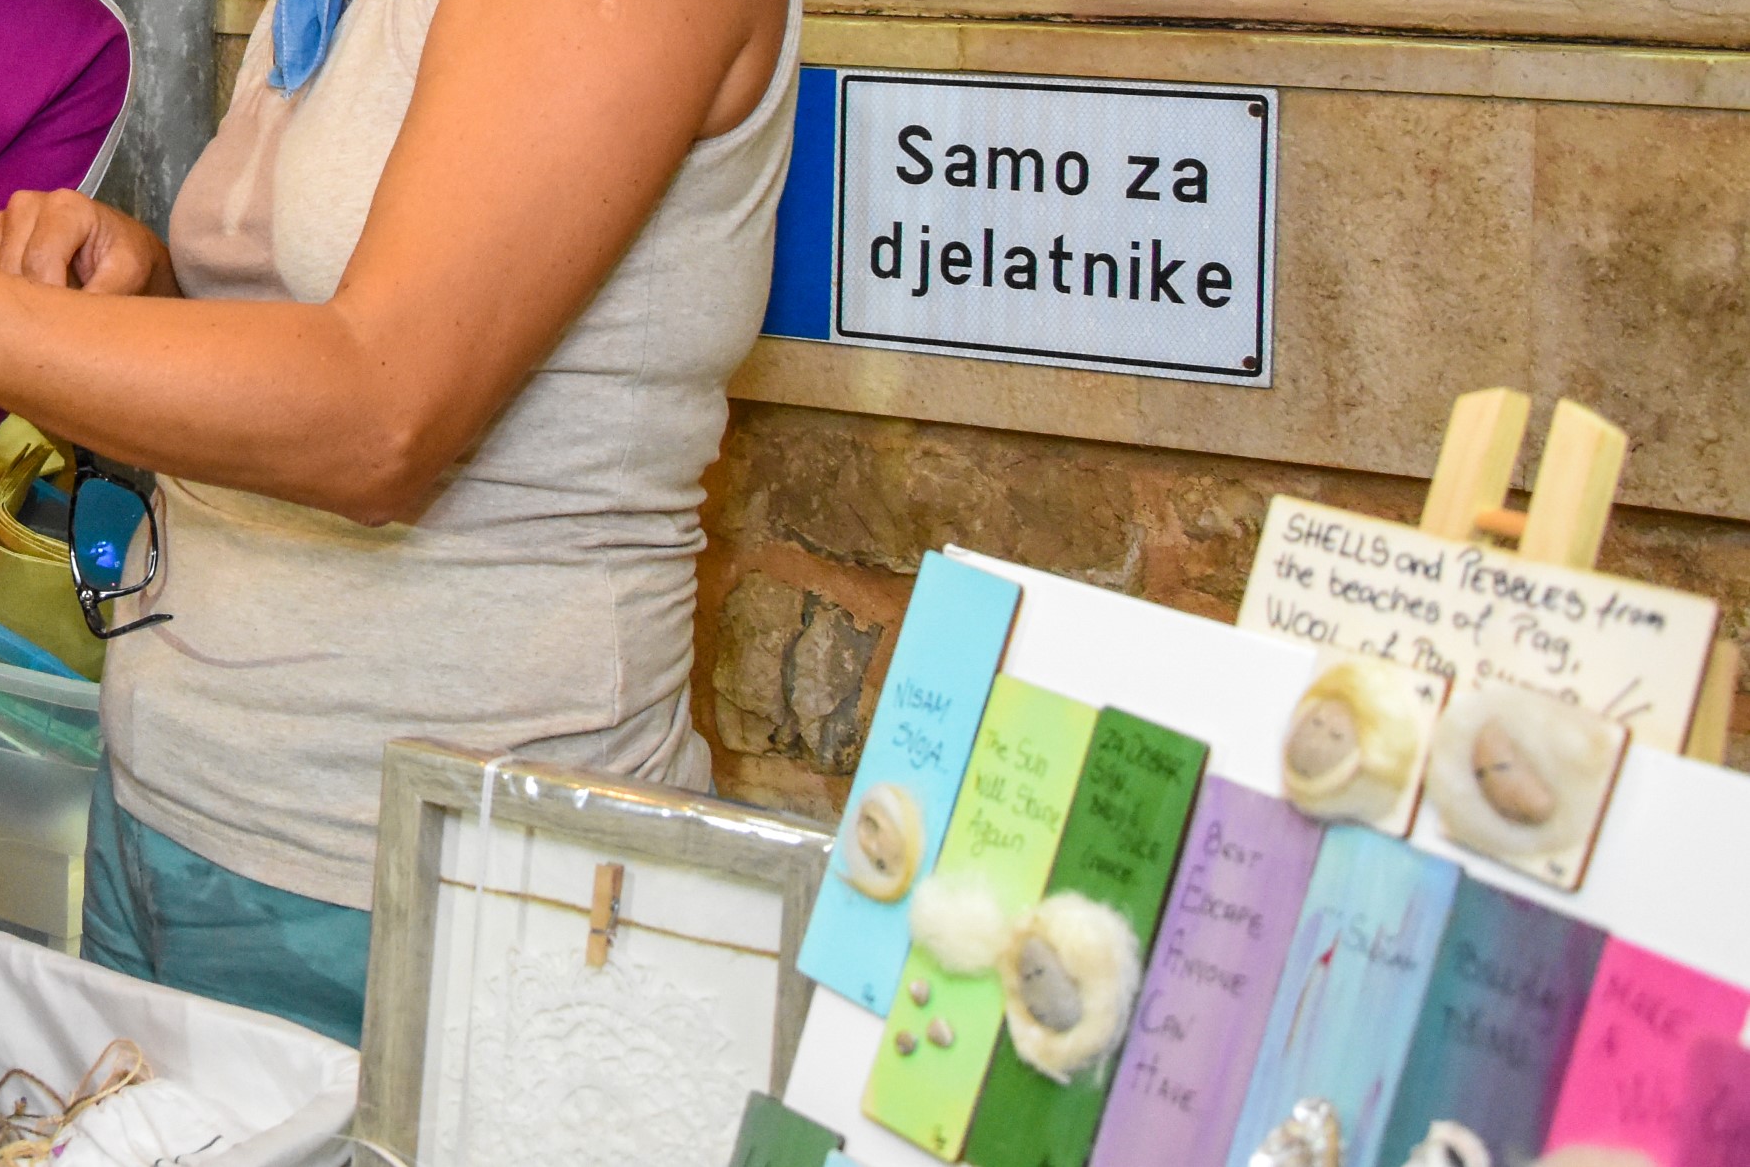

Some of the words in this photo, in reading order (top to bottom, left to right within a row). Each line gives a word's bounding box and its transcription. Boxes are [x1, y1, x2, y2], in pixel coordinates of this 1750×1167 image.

[896, 125, 1089, 196] Samo
[1126, 155, 1208, 204] za
[869, 221, 1233, 309] djelatnike
[1273, 552, 1315, 589] the
[1328, 568, 1441, 625] beaches
[1453, 604, 1494, 647] of
[1510, 611, 1582, 674] Pag,
[1283, 512, 1390, 567] SHELLS
[1395, 550, 1445, 582] and
[1595, 590, 1668, 632] from
